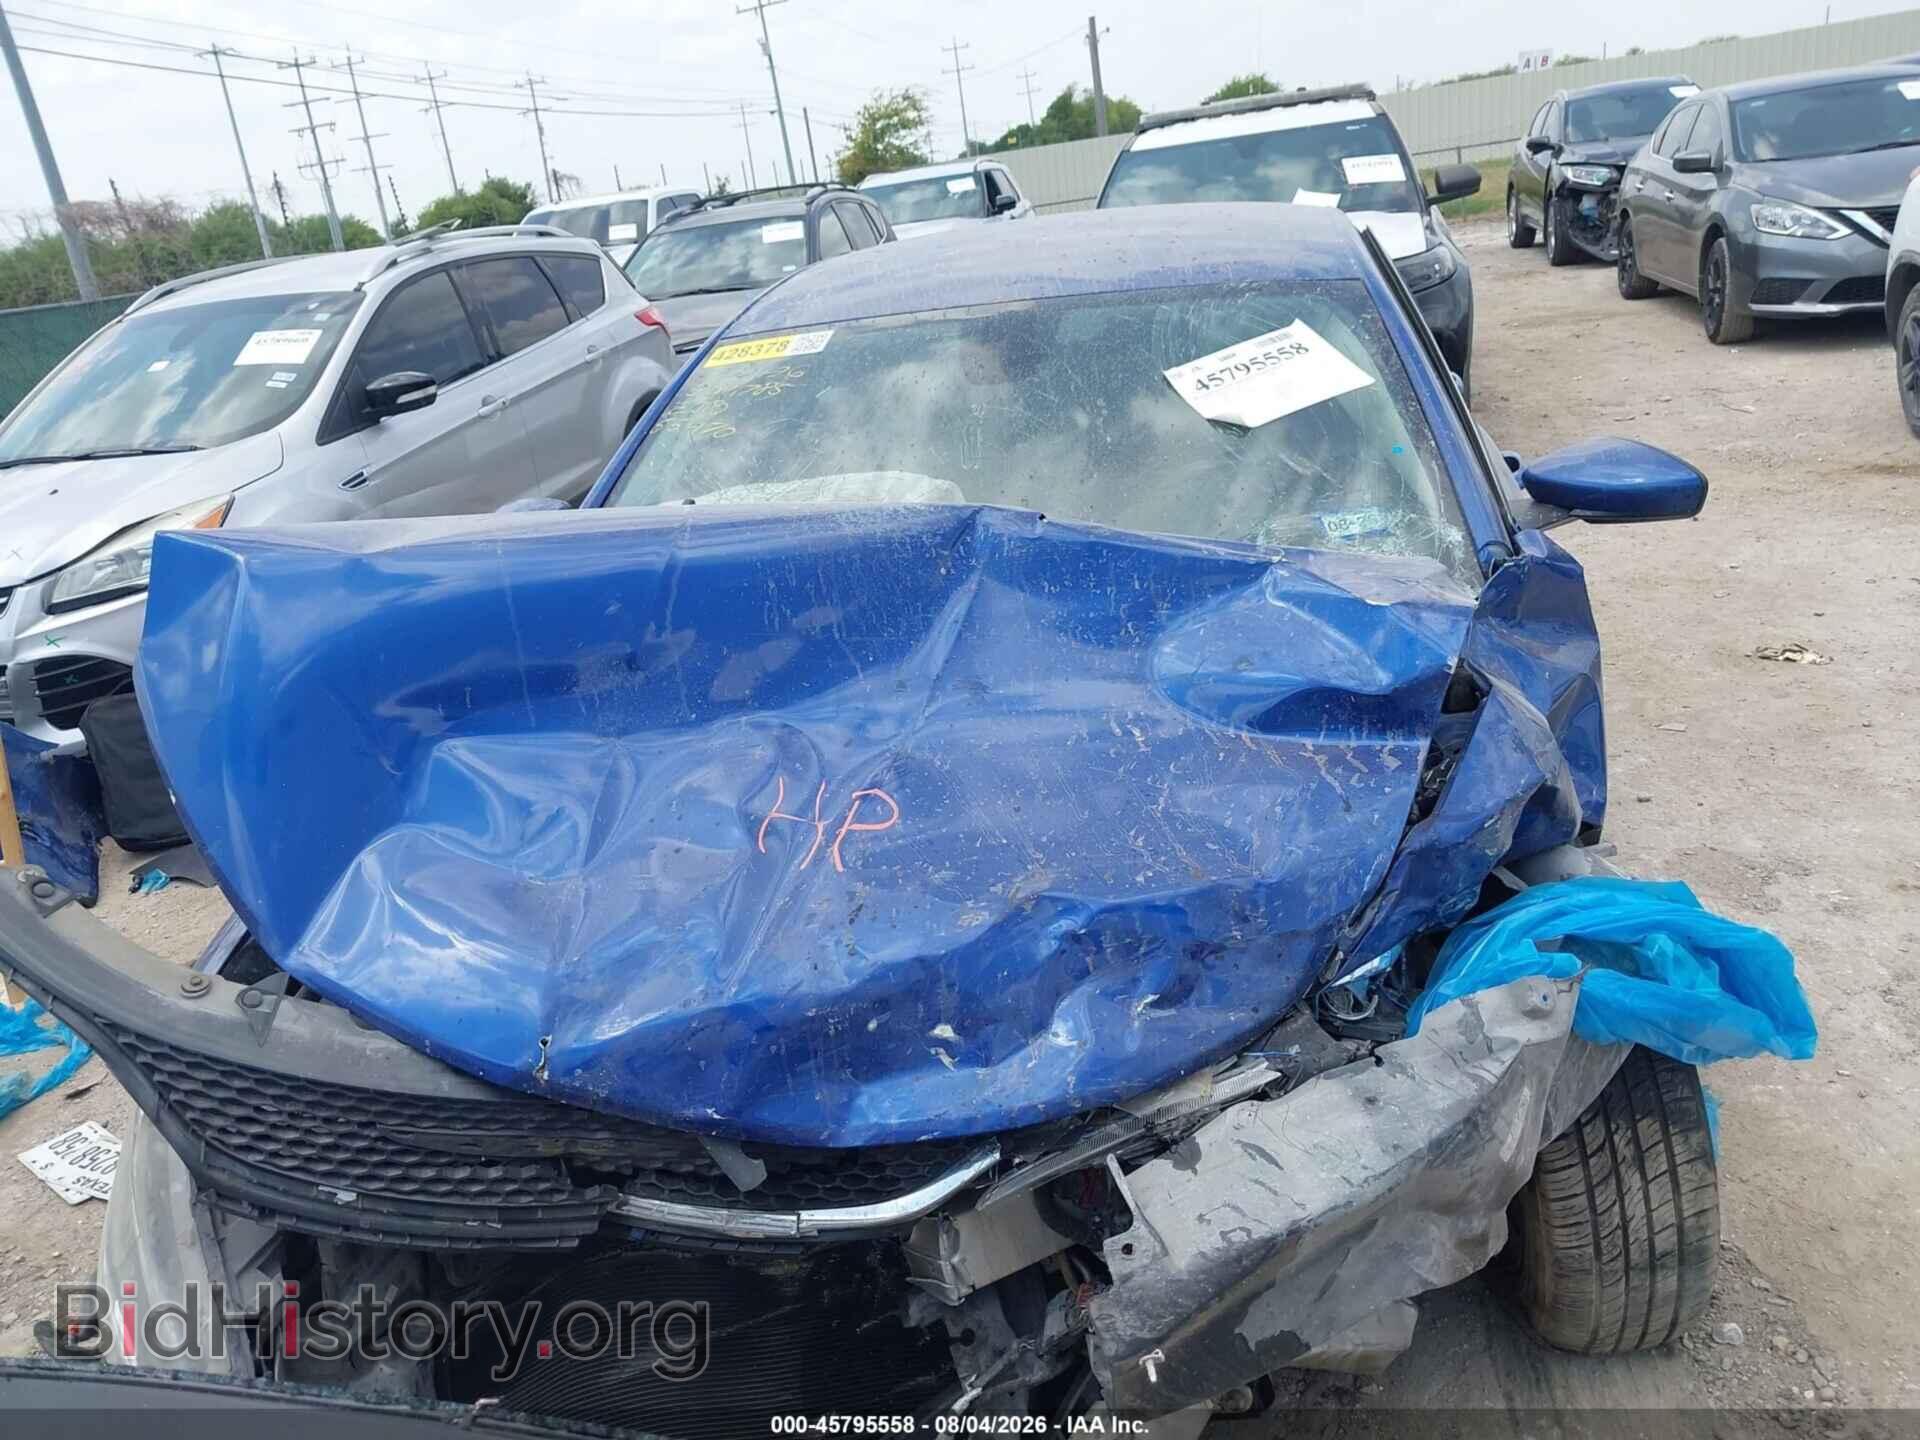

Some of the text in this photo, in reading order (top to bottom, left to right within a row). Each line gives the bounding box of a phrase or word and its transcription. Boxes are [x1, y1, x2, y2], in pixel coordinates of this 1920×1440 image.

[1195, 342, 1310, 393] 45795558
[758, 776, 899, 873] HP
[71, 1175, 113, 1195] TEXAS
